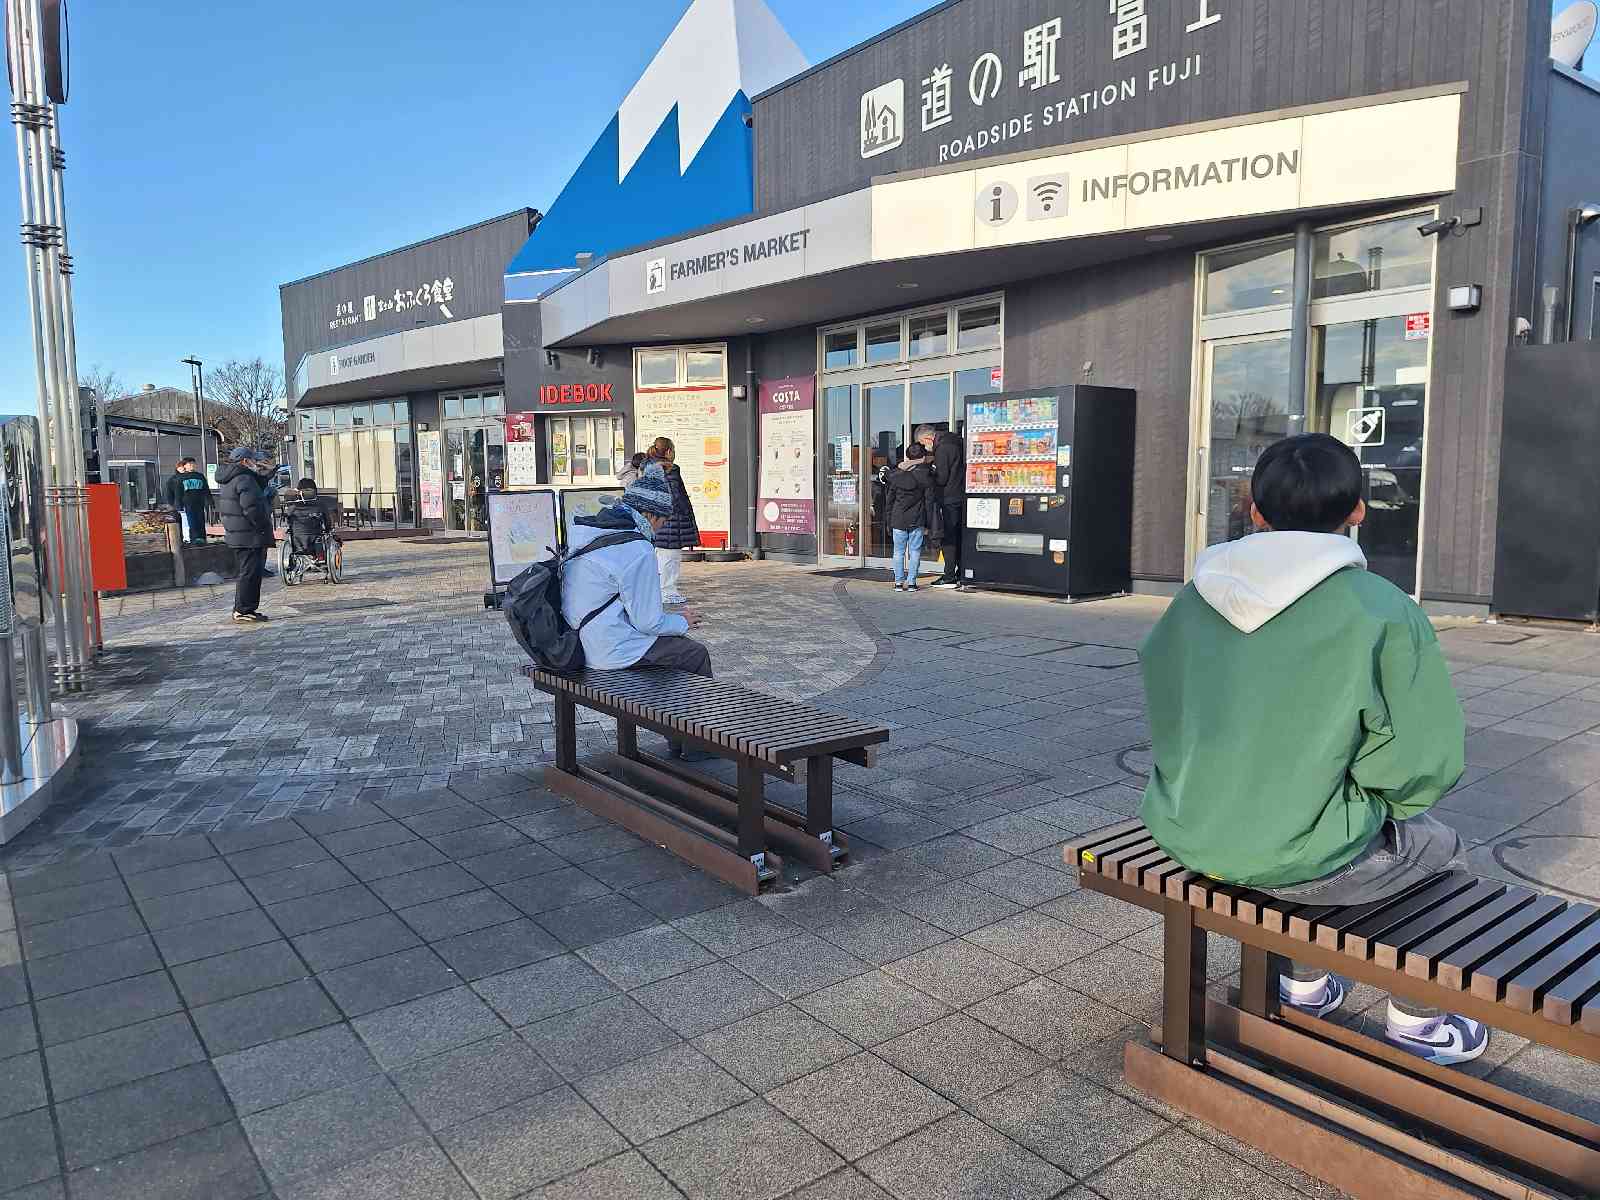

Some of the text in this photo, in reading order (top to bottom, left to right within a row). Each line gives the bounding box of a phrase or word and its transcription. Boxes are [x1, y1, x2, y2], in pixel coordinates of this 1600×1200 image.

[921, 17, 1063, 133] 道の駅
[939, 54, 1202, 163] ROADSIDE STATION FUJI
[1082, 149, 1299, 202] INFORMATION
[670, 229, 811, 281] FARMER'S MARKET
[540, 383, 613, 404] IDEBOK
[772, 390, 801, 404] COSTA
